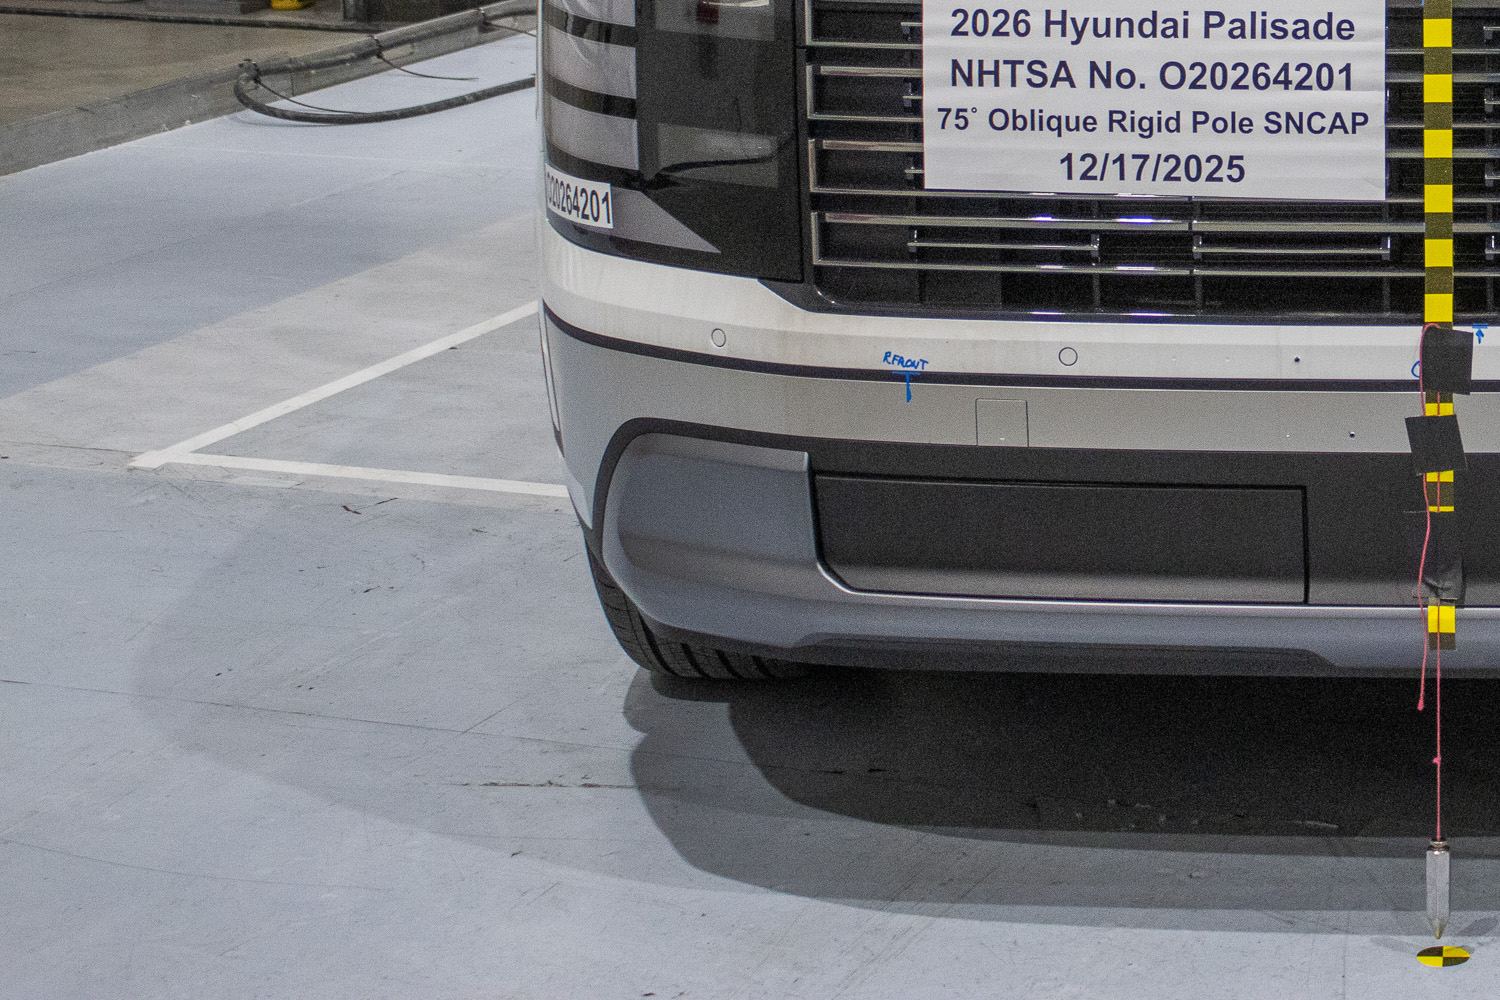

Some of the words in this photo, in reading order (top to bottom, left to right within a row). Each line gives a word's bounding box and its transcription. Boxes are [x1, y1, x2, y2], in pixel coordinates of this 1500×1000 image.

[950, 8, 1032, 38] 2026
[1044, 9, 1190, 46] Hyundai
[1203, 10, 1356, 41] Palisade
[951, 59, 1077, 89] NHTSA
[1089, 60, 1147, 90] No.
[1159, 61, 1353, 92] O20264201
[937, 107, 978, 131] 75°
[988, 108, 1098, 138] Oblique
[1108, 110, 1181, 139] Rigid
[1192, 110, 1254, 134] Pole
[1263, 111, 1369, 135] SNCAP
[1060, 152, 1246, 183] 12/17/2025
